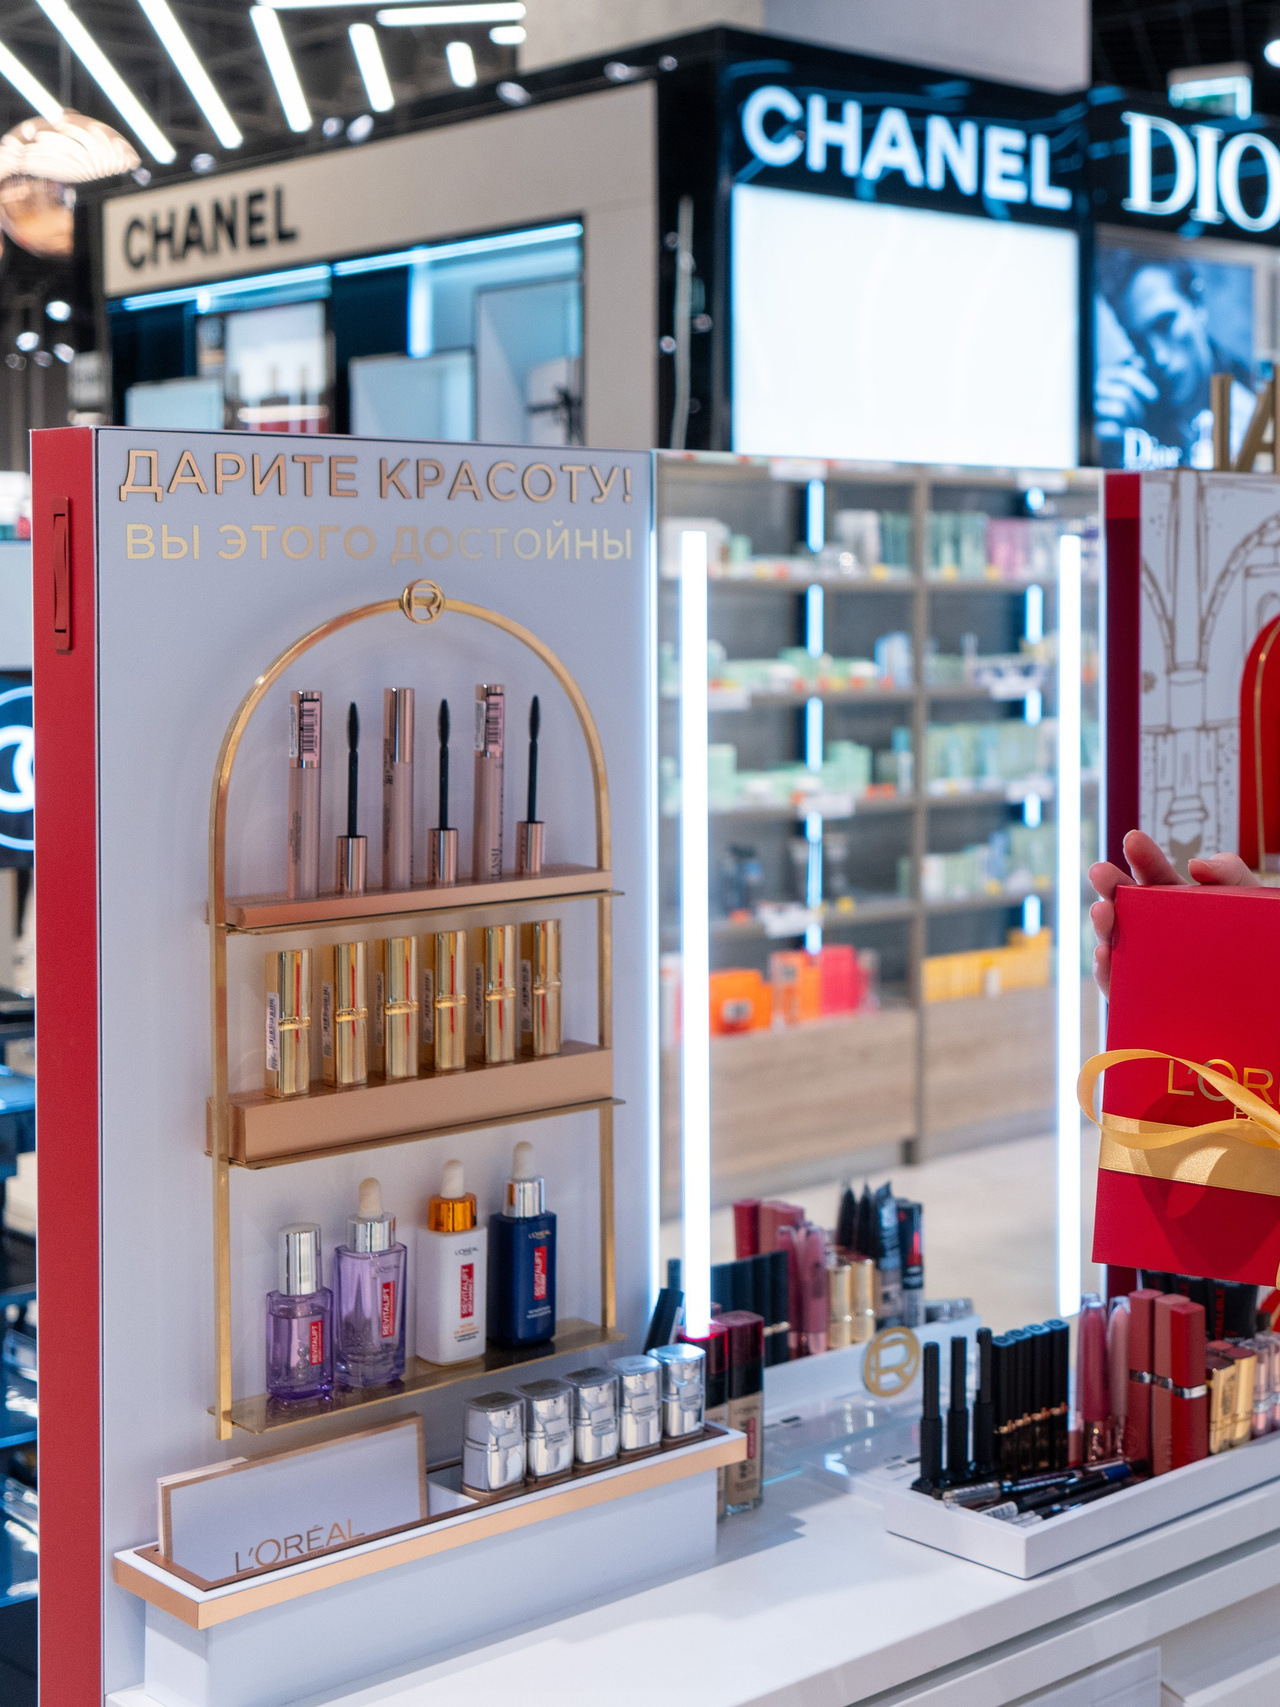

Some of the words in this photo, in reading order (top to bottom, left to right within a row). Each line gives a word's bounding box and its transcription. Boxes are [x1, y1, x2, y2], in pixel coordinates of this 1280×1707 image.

[741, 85, 1073, 211] CHANEL
[124, 185, 297, 270] CHANEL
[119, 449, 358, 503] ДАРИТЕ
[379, 458, 632, 504] КРАСОТУ!
[126, 524, 199, 560] ВЫ
[218, 524, 376, 561] ЭТОГО
[390, 519, 632, 567] ДОСТОЙНЫ
[234, 1518, 366, 1574] L'ORÉAL
